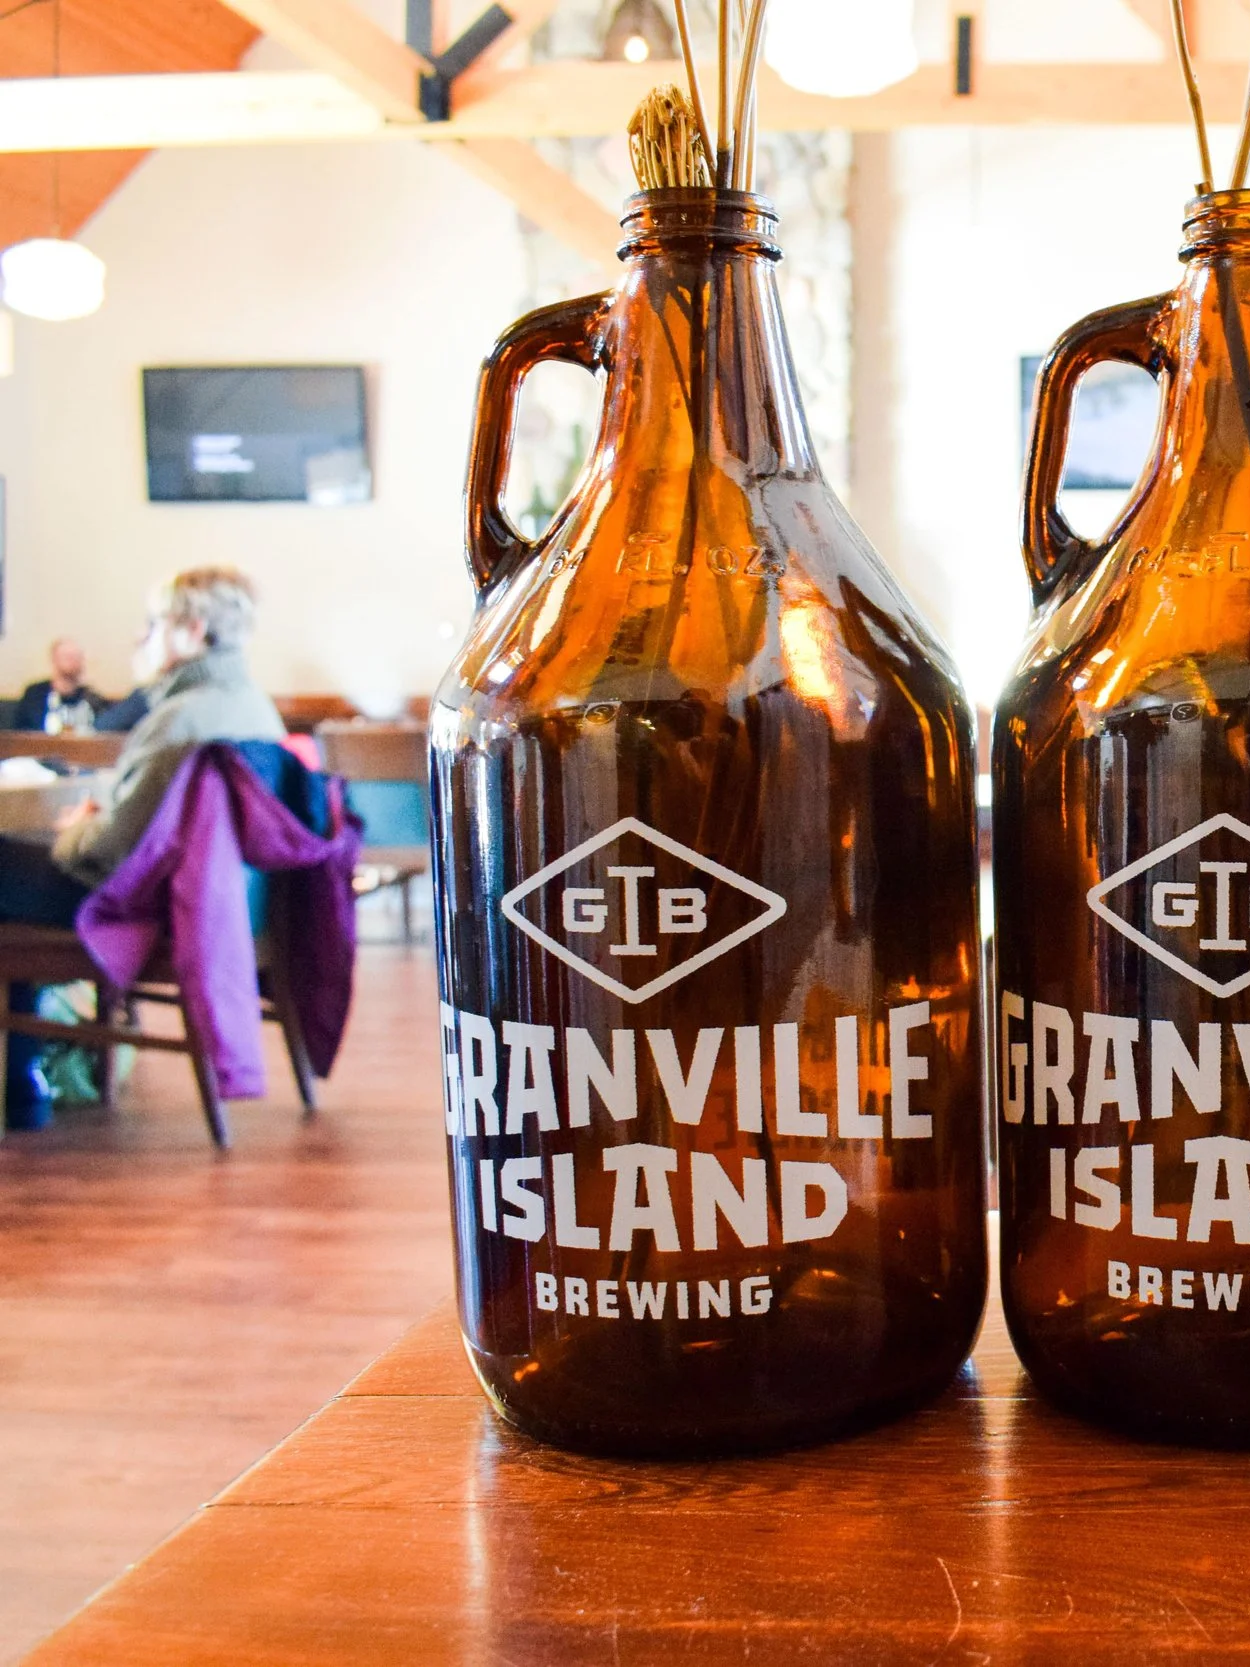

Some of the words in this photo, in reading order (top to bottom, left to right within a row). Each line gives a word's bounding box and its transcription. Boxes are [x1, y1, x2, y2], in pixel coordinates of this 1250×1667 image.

[562, 866, 708, 956] GIB
[440, 1000, 933, 1139] GRANVILLE
[480, 1142, 849, 1252] ISLAND
[535, 1271, 774, 1320] BREWING
